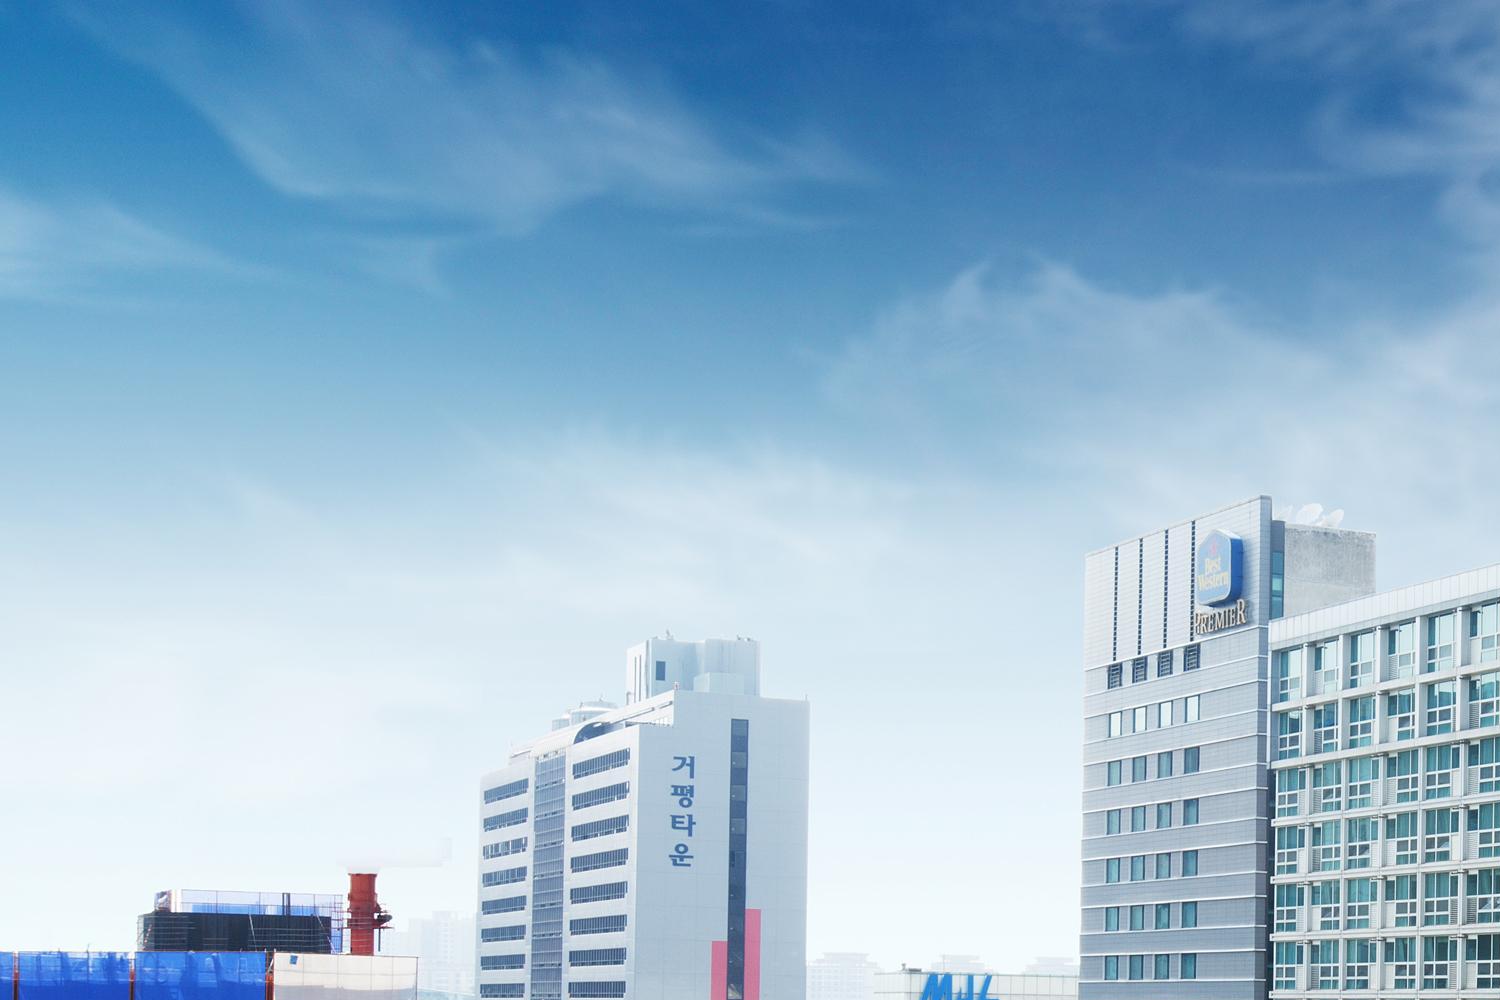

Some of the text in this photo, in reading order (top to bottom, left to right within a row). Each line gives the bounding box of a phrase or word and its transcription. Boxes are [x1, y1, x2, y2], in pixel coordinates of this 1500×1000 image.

[1205, 556, 1221, 574] Best
[1198, 571, 1230, 592] Western
[1195, 598, 1247, 634] PREMIER
[668, 756, 697, 868] 거평타운
